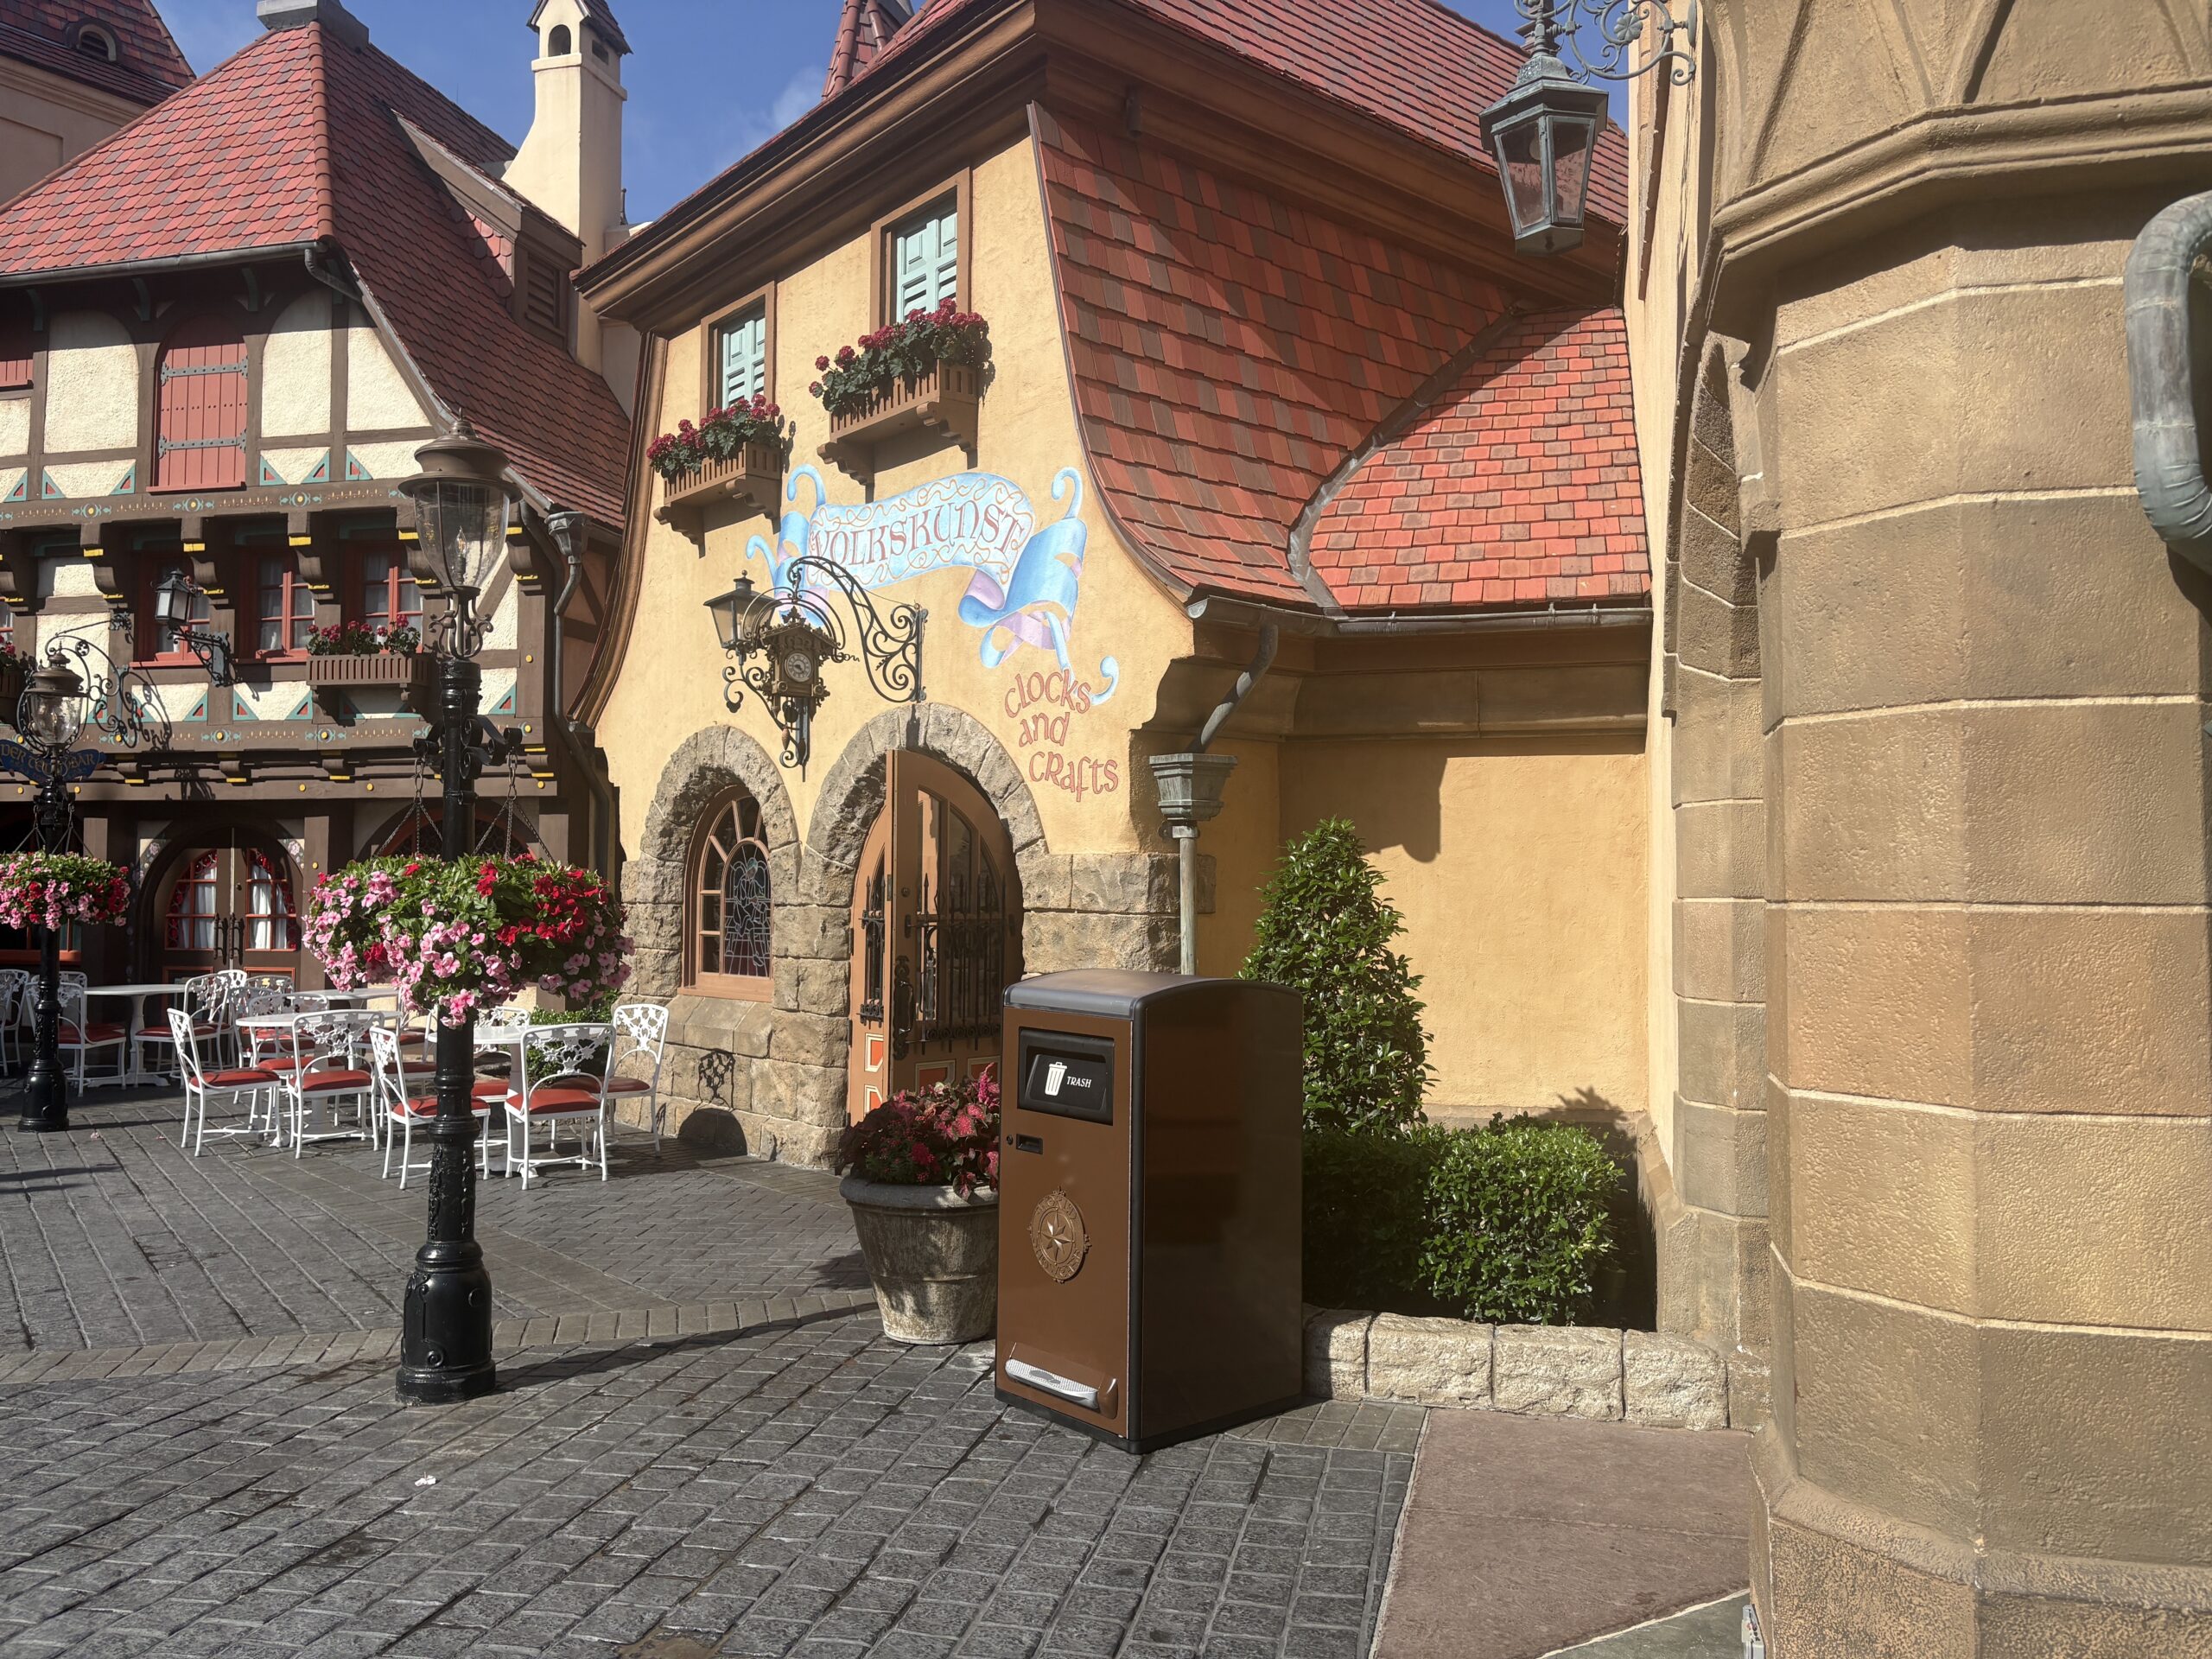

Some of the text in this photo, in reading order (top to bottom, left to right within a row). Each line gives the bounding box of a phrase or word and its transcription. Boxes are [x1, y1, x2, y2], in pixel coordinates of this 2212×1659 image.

[811, 499, 1025, 565] VOLKSKUNST
[1019, 712, 1071, 747] and
[1066, 1076, 1092, 1089] TRASH
